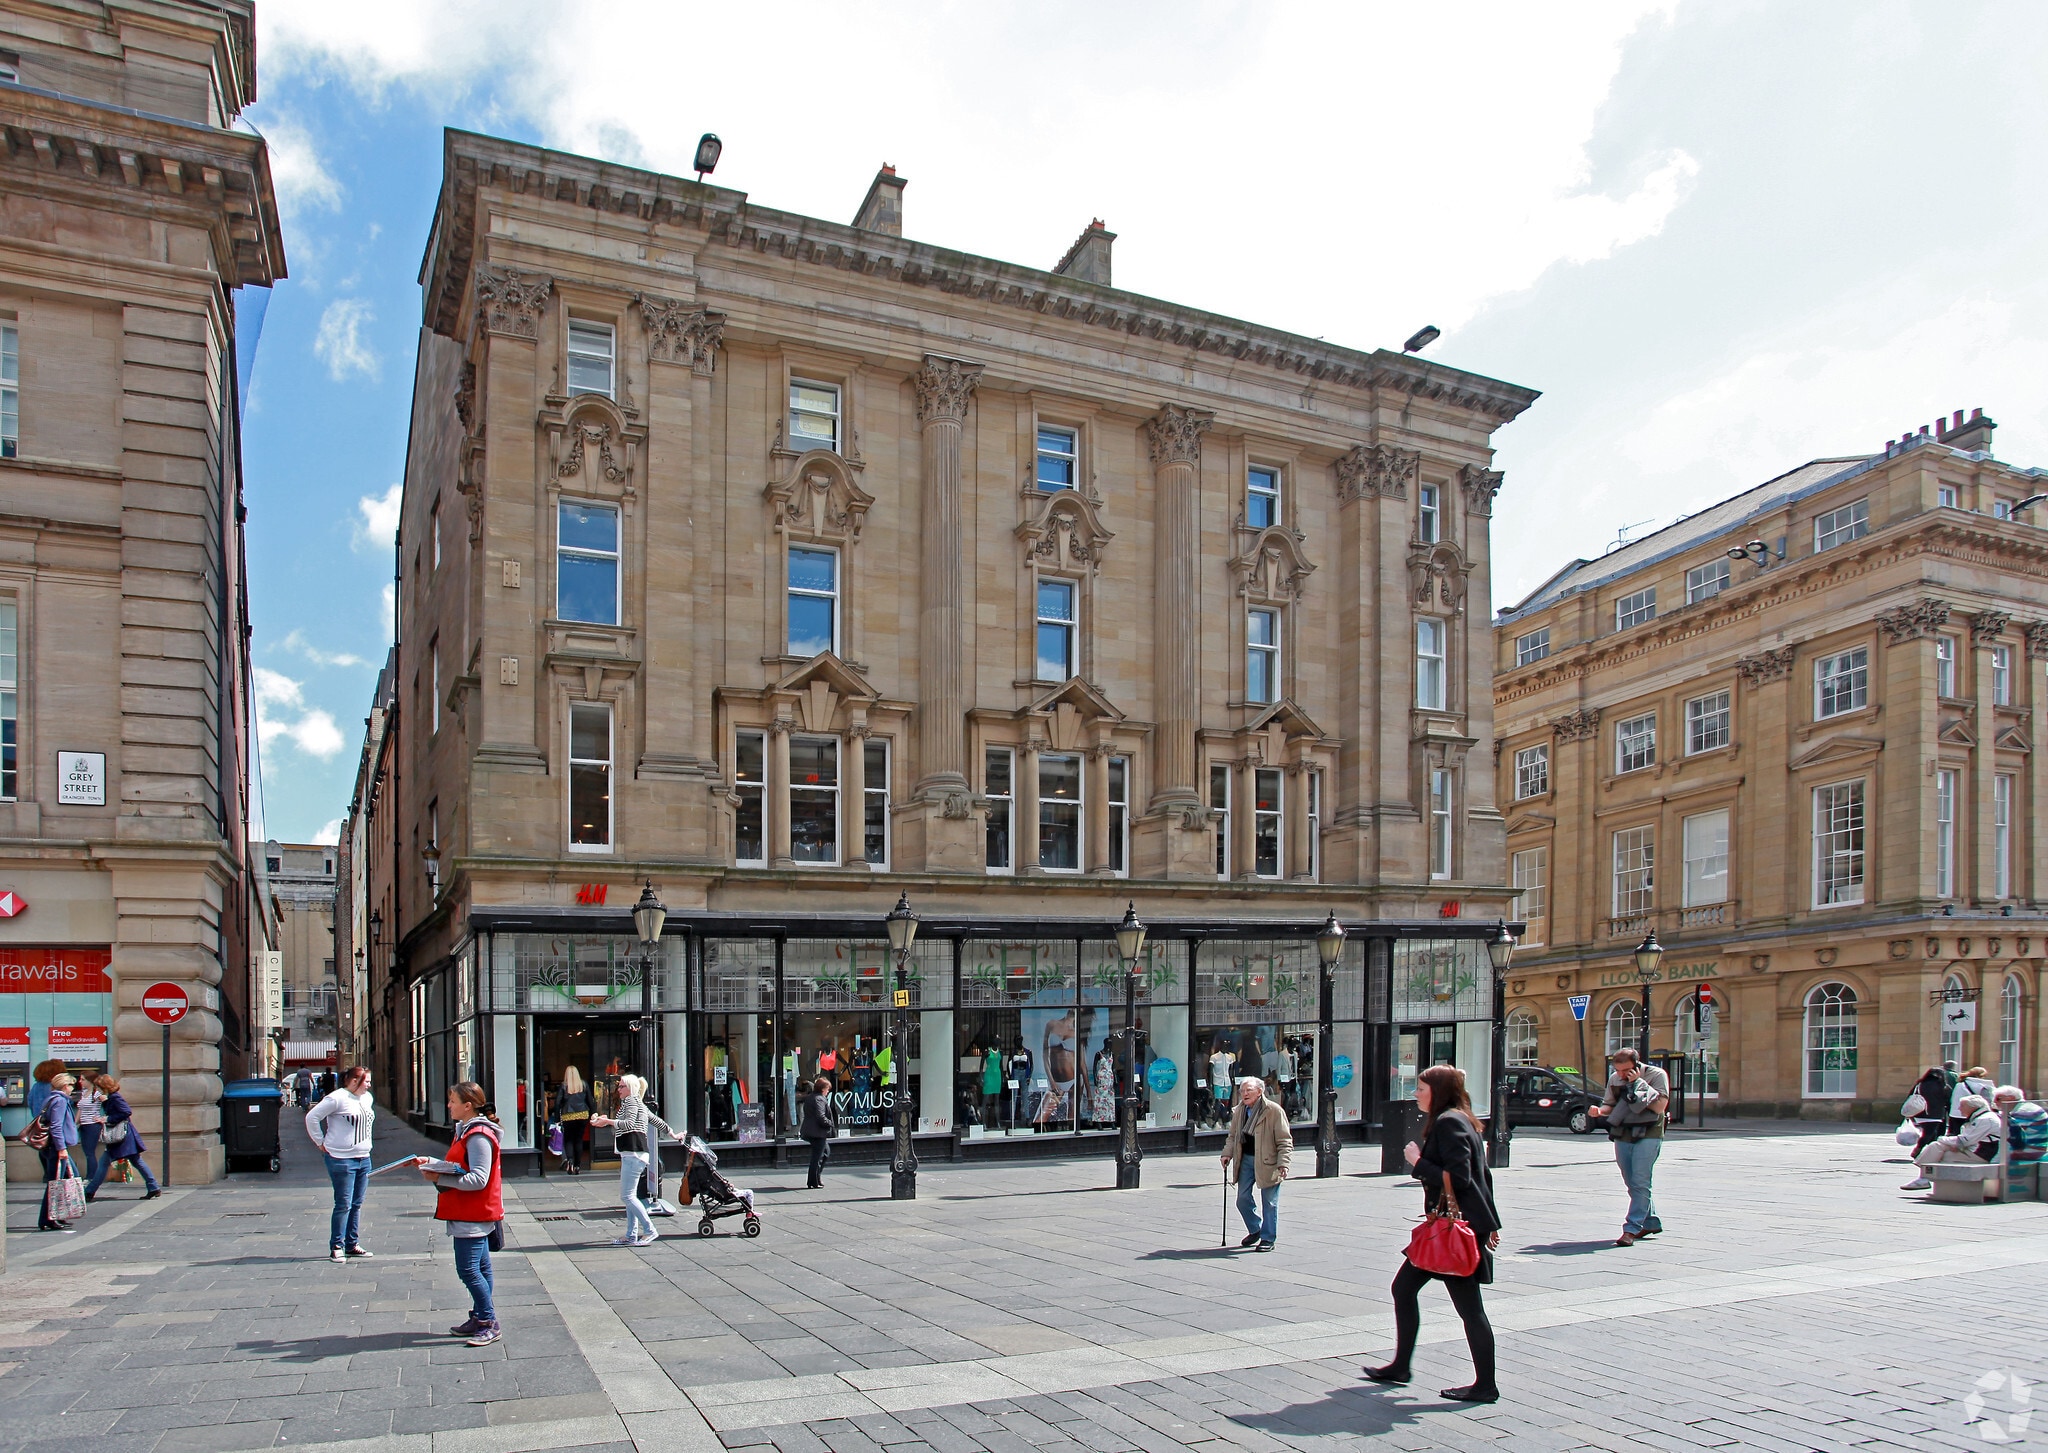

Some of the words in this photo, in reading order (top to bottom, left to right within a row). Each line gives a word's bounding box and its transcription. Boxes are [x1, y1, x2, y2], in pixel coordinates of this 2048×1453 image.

[69, 772, 94, 782] GREY
[64, 784, 98, 793] STREET
[575, 883, 608, 906] H&M
[1600, 970, 1663, 987] LLOYS
[1668, 961, 1718, 980] BANK
[270, 957, 279, 1021] CINEMA
[896, 991, 907, 1006] H
[52, 1029, 71, 1037] Free
[837, 1114, 879, 1125] hm.com
